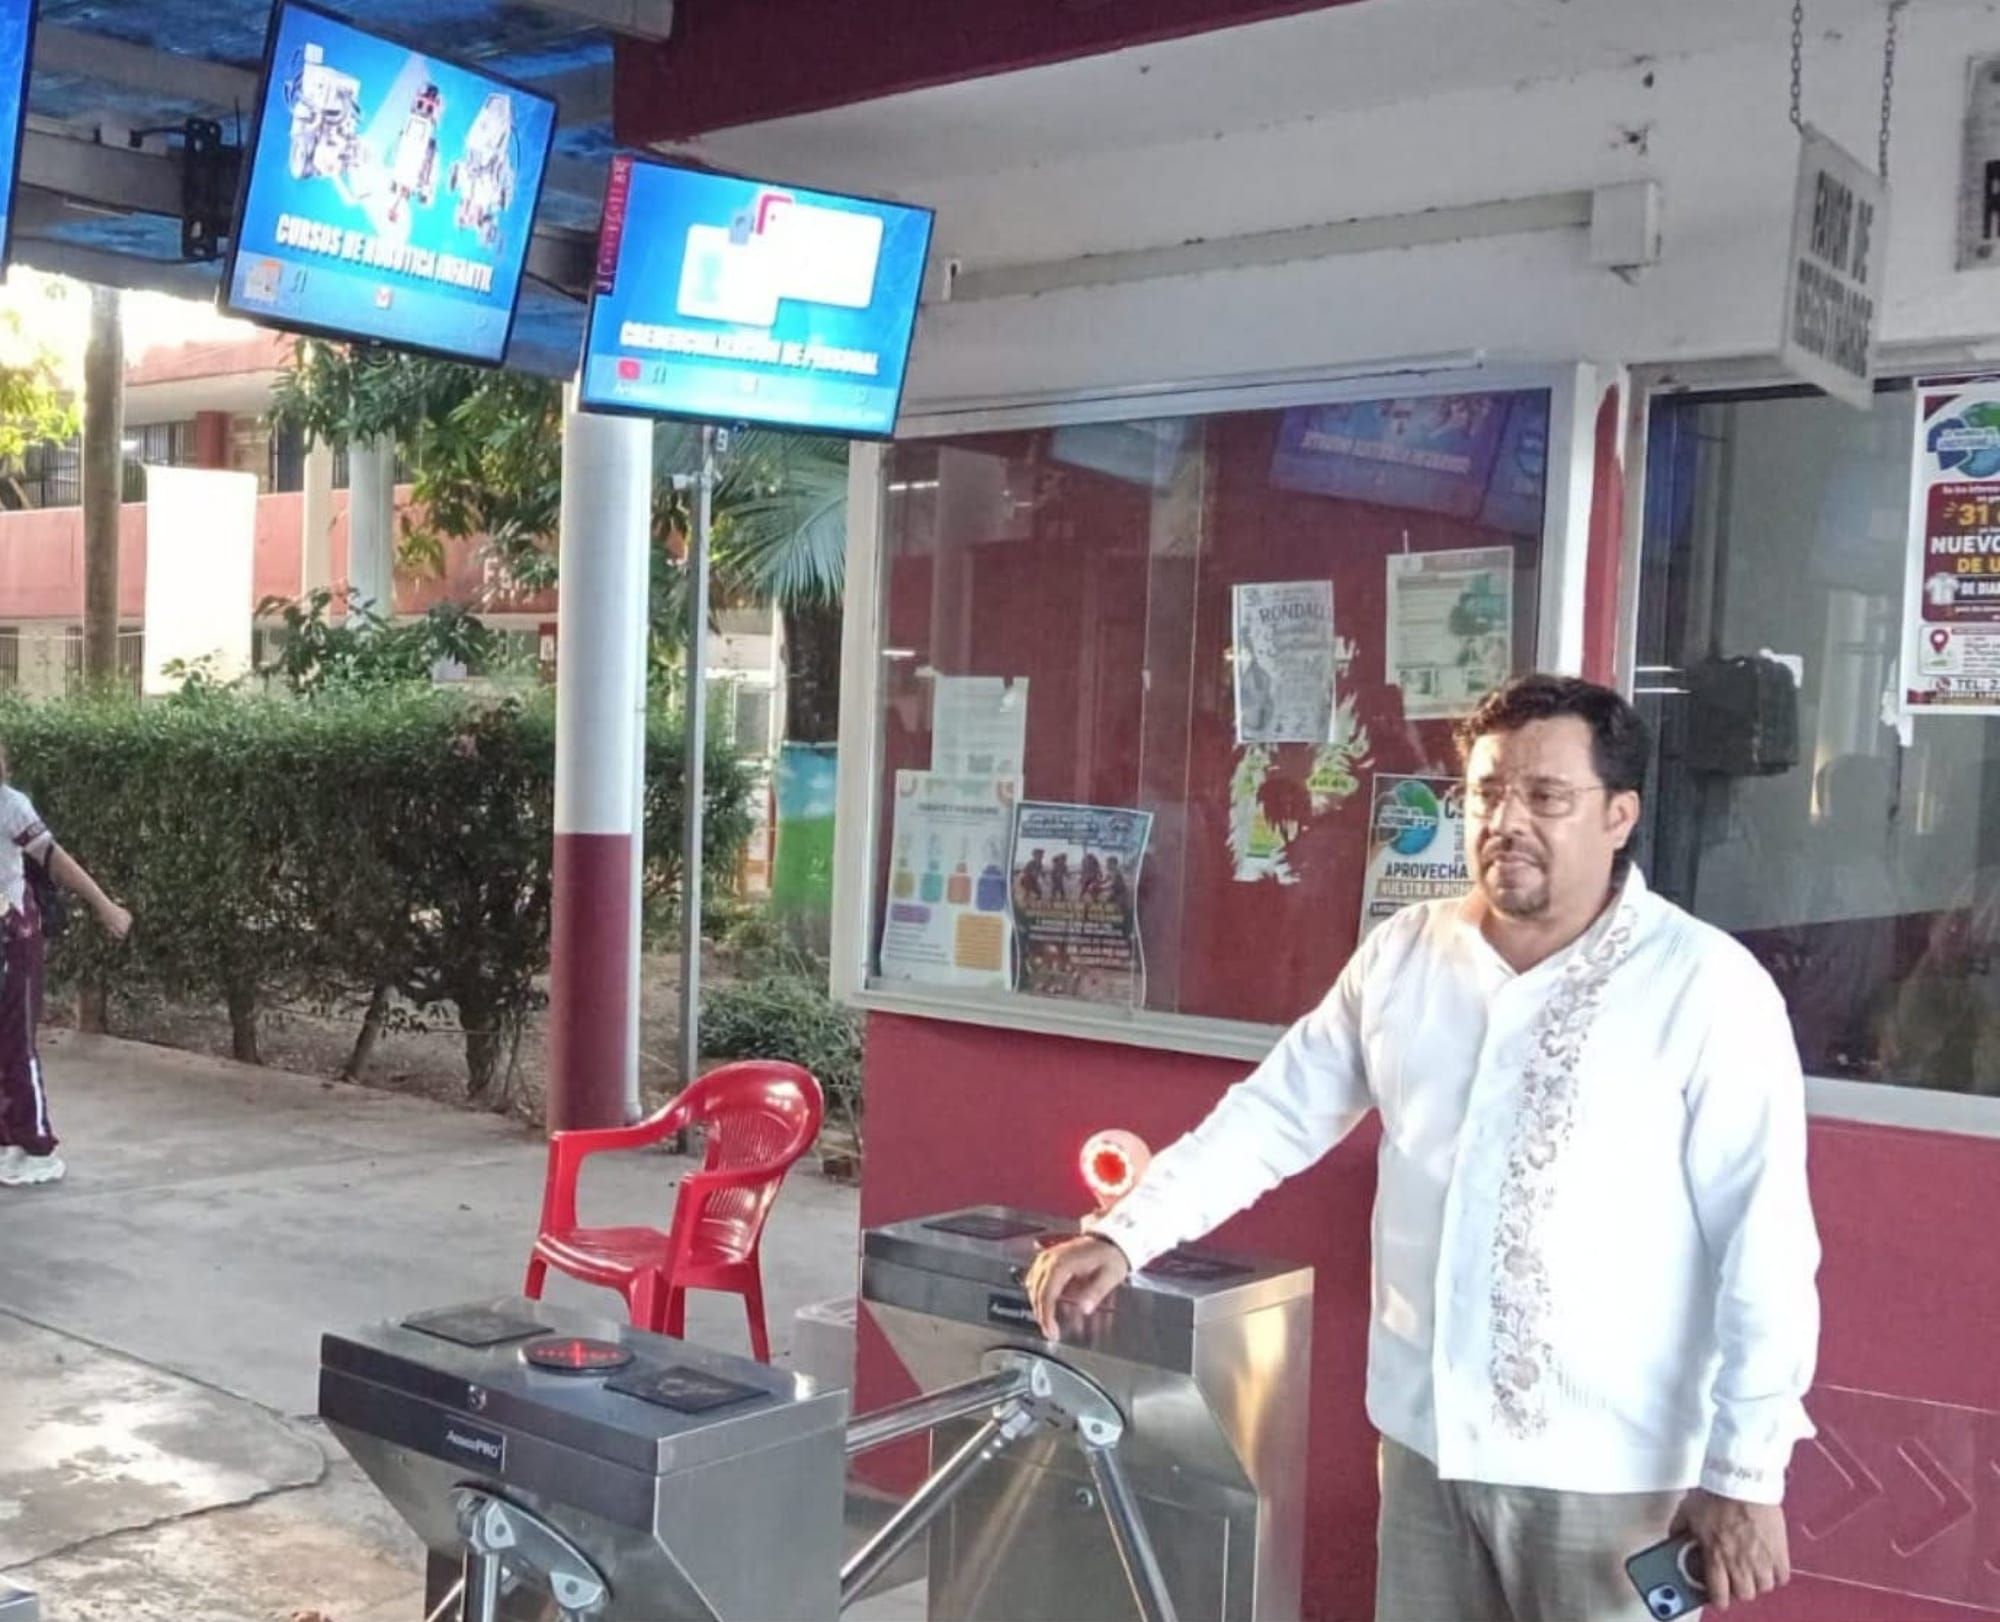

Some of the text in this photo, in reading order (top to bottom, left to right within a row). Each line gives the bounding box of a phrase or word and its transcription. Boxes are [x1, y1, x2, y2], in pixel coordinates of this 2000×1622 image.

[1958, 503, 1988, 526] 31
[1956, 557, 1982, 573] DE
[1384, 861, 1469, 880] APROVECHA
